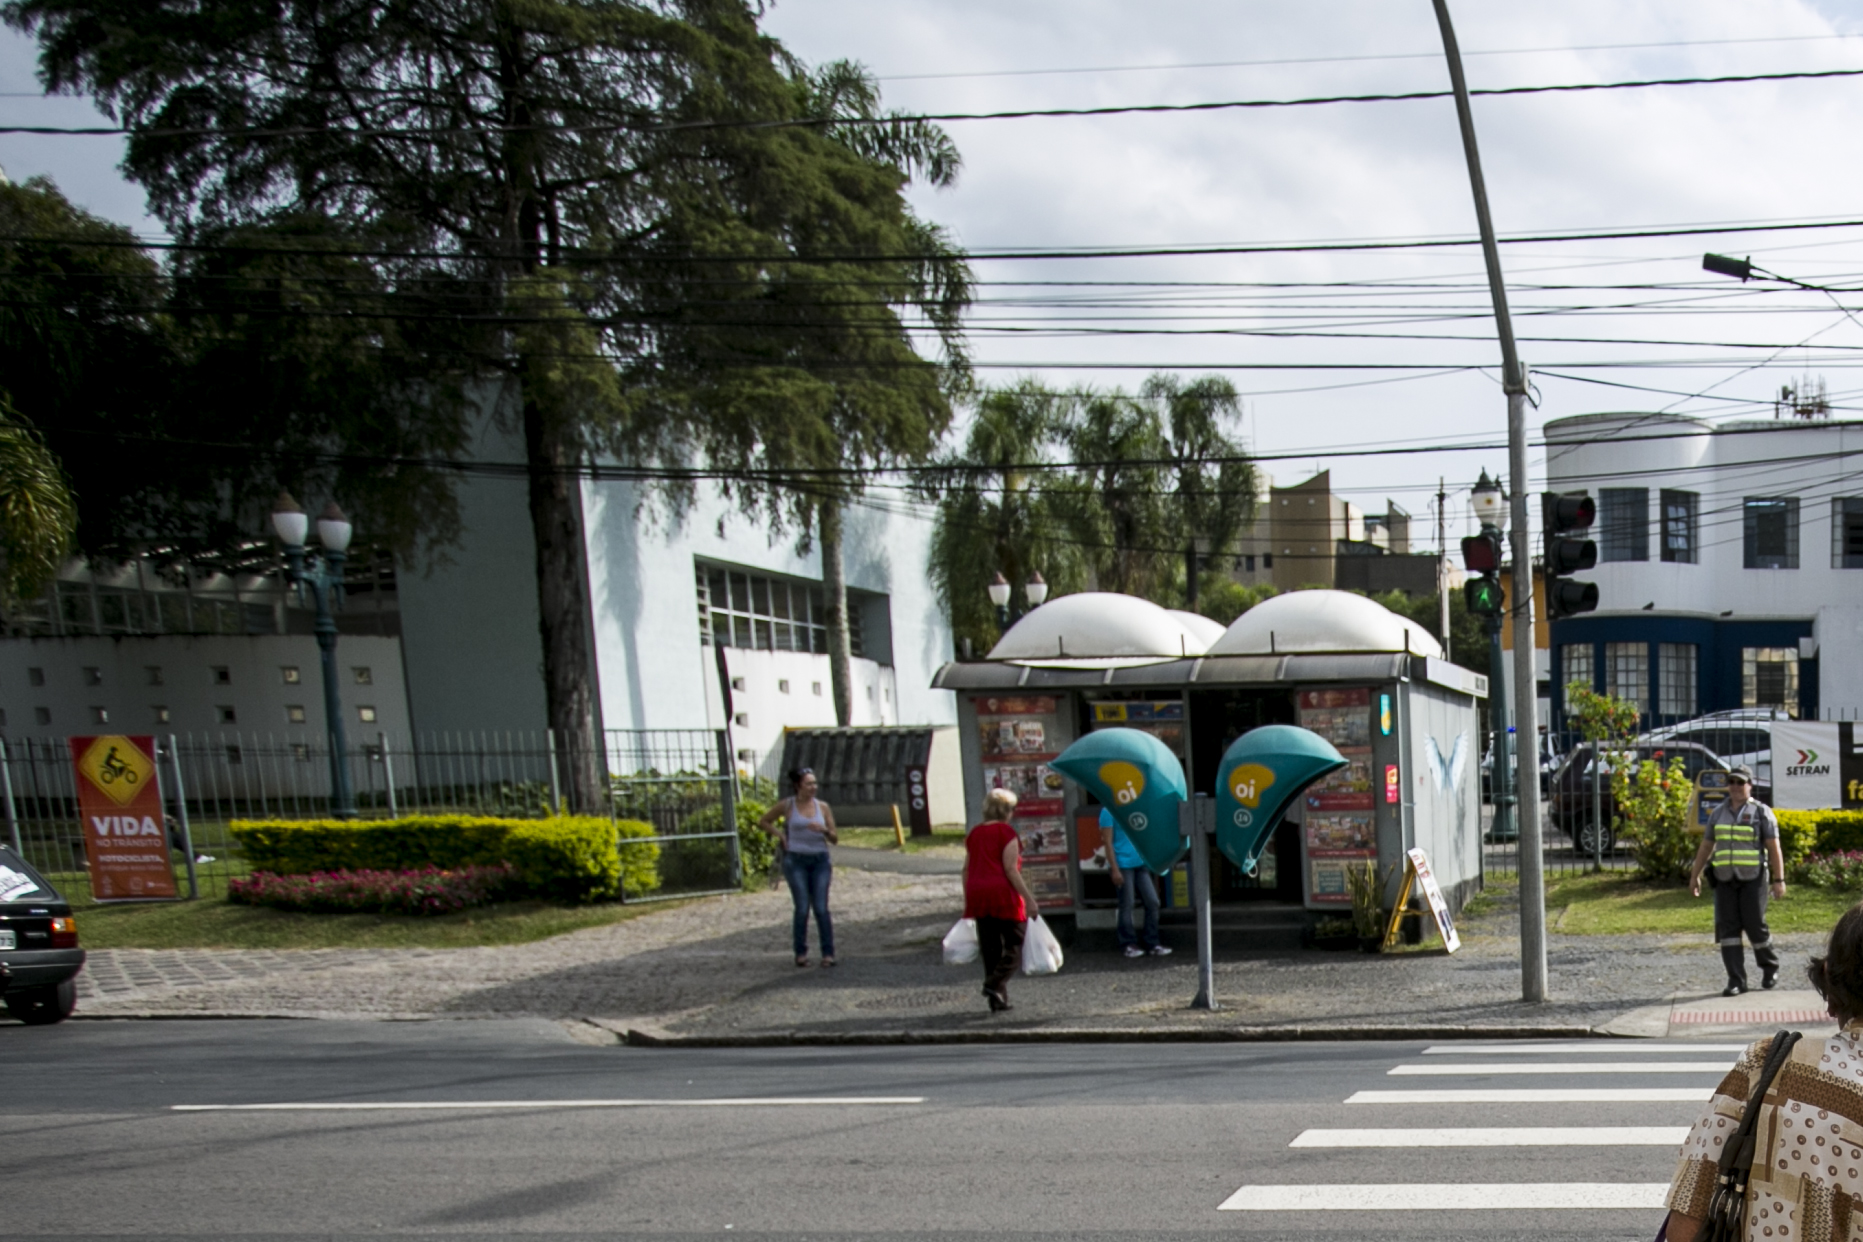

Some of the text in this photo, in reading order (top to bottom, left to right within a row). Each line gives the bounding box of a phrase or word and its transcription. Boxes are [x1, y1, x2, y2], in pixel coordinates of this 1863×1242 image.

[1786, 765, 1830, 776] SETRAN
[1117, 780, 1138, 803] oi
[1235, 779, 1255, 799] oi
[91, 816, 161, 836] VIDA
[96, 839, 110, 847] NO
